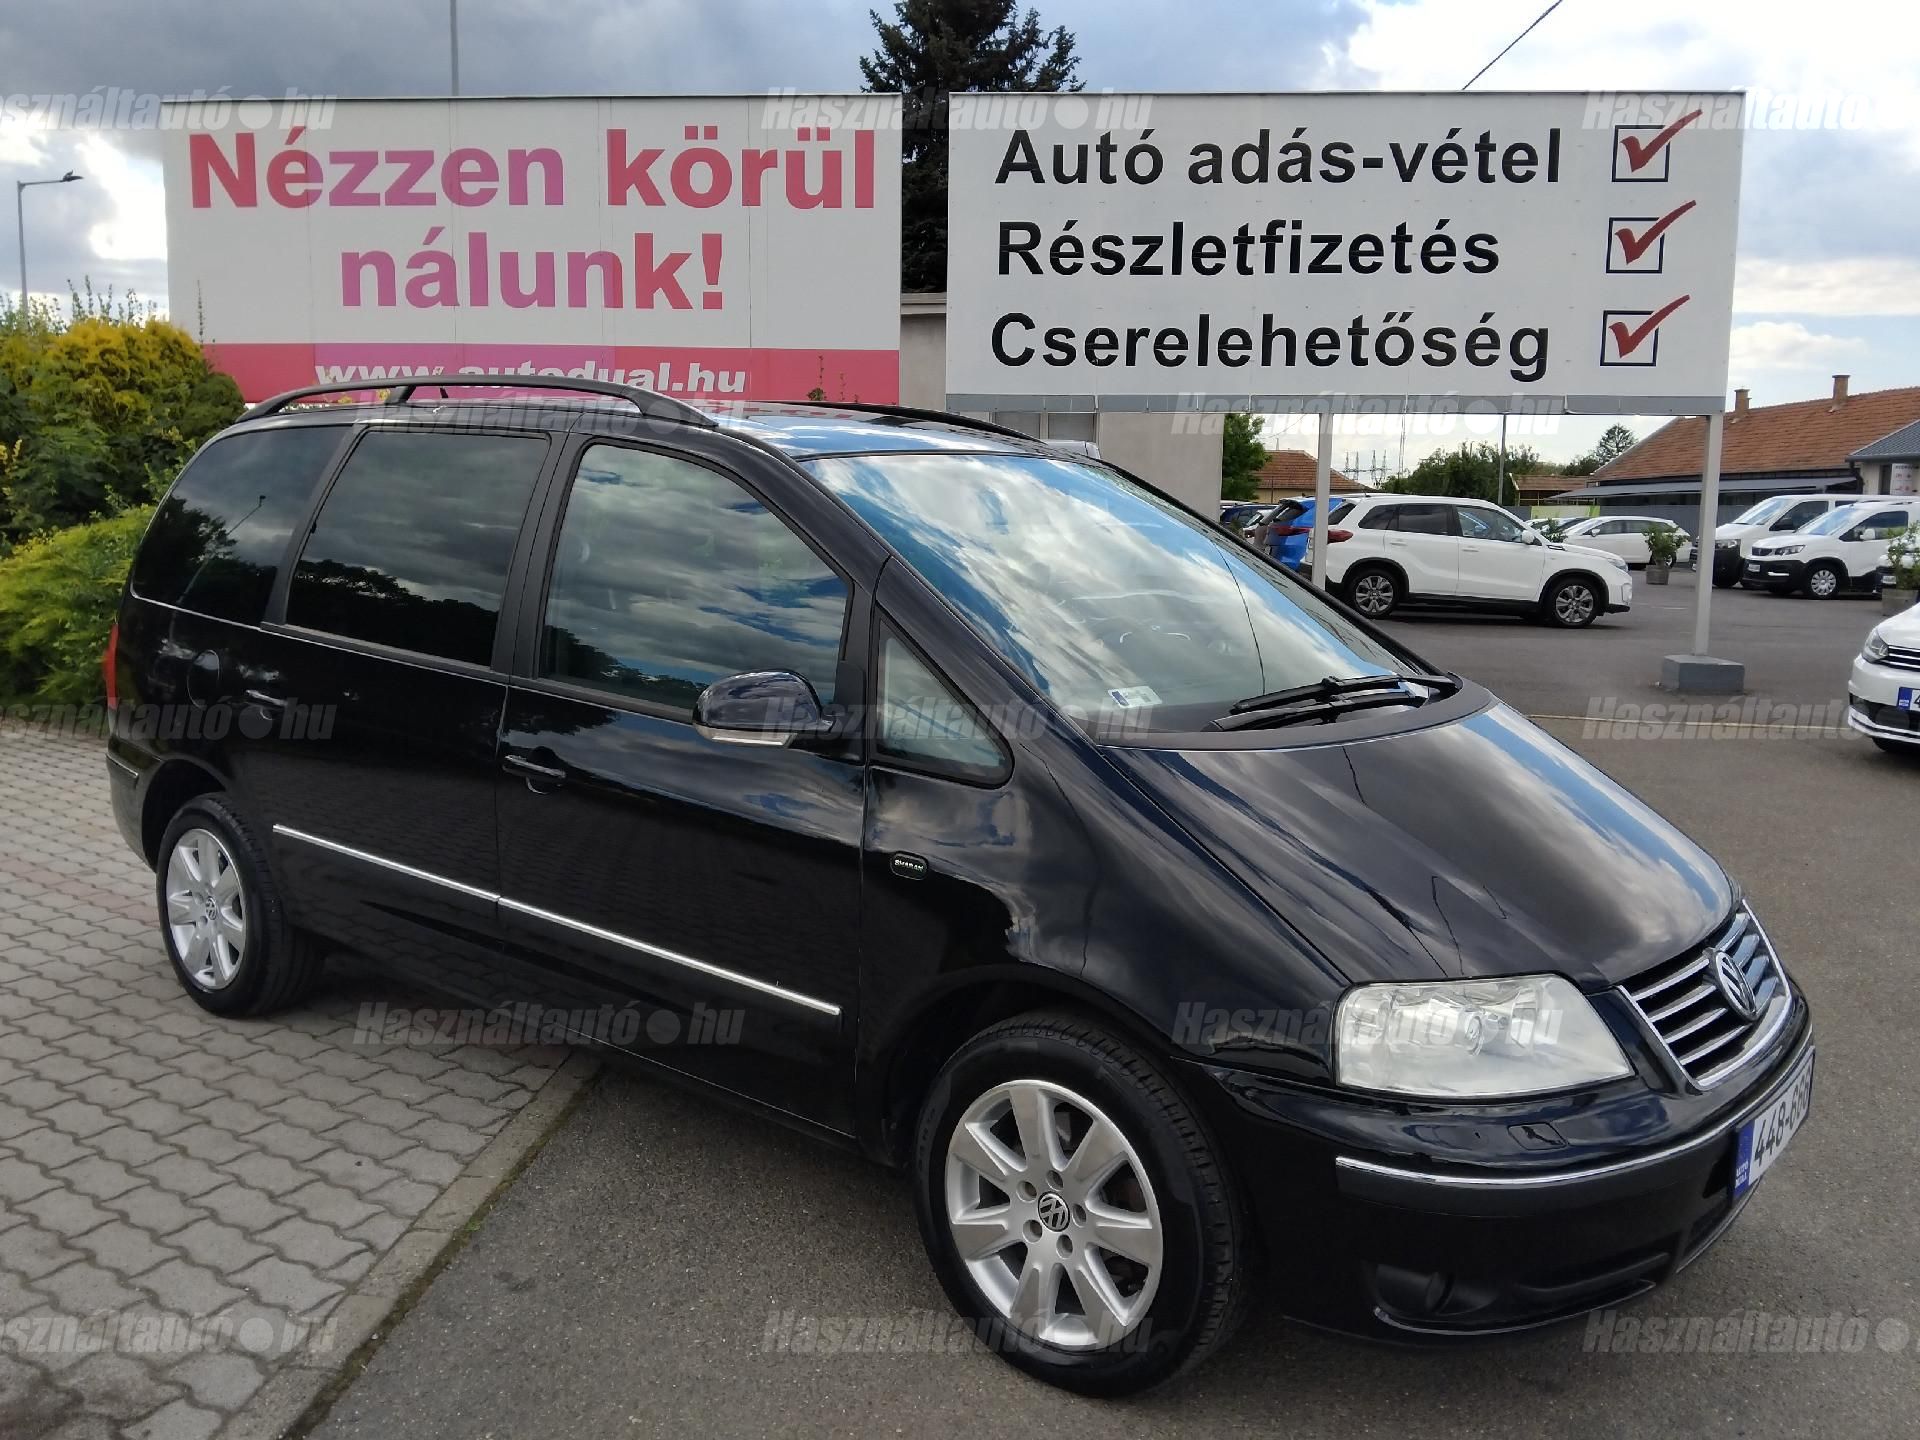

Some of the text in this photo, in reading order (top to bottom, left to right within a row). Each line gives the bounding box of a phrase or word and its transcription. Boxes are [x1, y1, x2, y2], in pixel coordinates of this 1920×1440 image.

[190, 126, 874, 210] Nézzen körül
[996, 127, 1561, 185] Autó adás-vétel
[343, 228, 724, 310] nálunk!
[998, 218, 1499, 275] Részletfizetés
[991, 311, 1549, 383] Cserelehetőség
